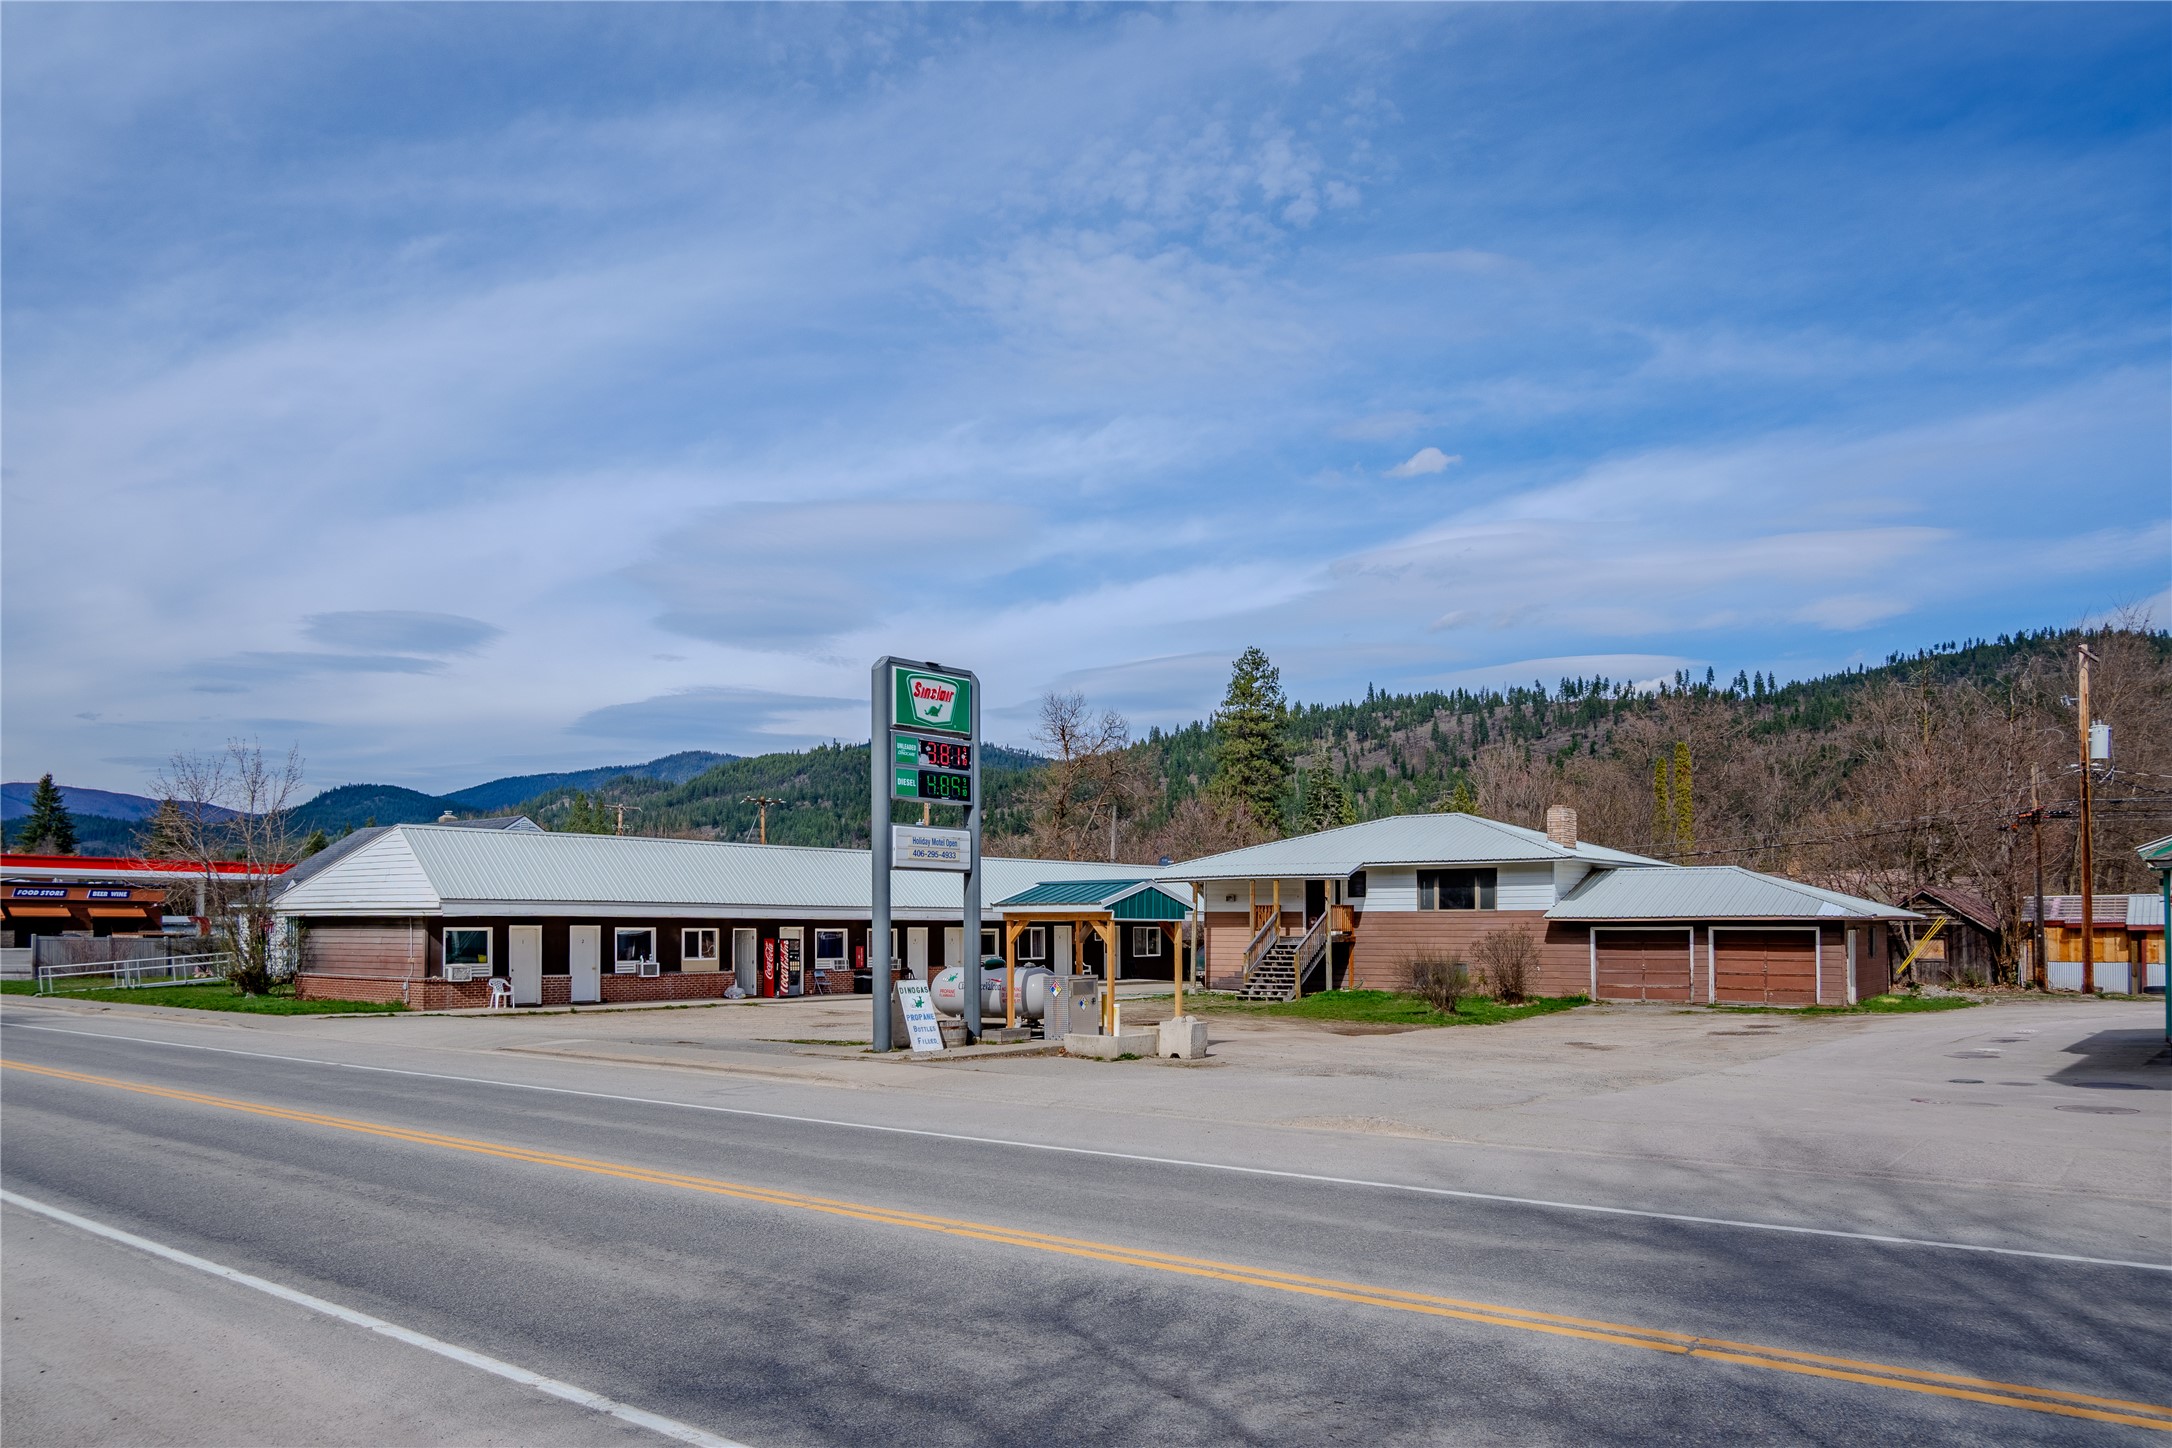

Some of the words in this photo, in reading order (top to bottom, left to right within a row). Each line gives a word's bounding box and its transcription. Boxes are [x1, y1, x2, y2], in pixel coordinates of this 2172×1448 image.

[913, 681, 955, 703] Sinclair
[897, 778, 917, 787] DIESEL
[912, 836, 931, 848] Holiday
[931, 837, 946, 847] Motel
[946, 838, 958, 848] Open
[912, 849, 957, 859] 406-295-4933
[40, 889, 65, 897] STORE
[906, 1013, 936, 1022] PROPANE
